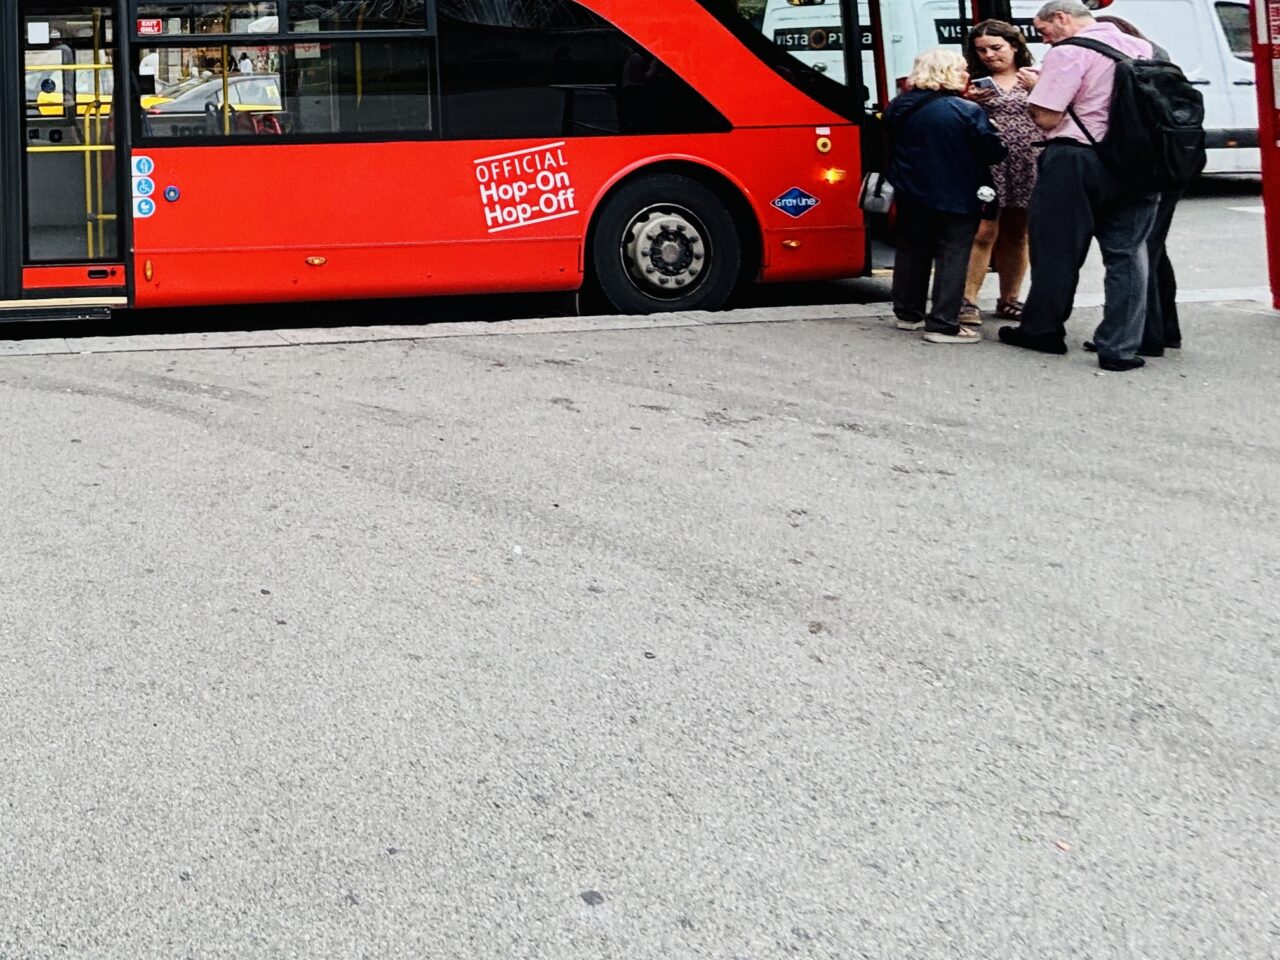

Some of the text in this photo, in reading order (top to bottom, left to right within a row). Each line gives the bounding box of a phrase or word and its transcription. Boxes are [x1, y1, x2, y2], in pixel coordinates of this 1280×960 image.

[476, 149, 568, 183] OFFICIAL
[480, 170, 570, 205] Hop-On
[484, 188, 575, 227] Hop-Off
